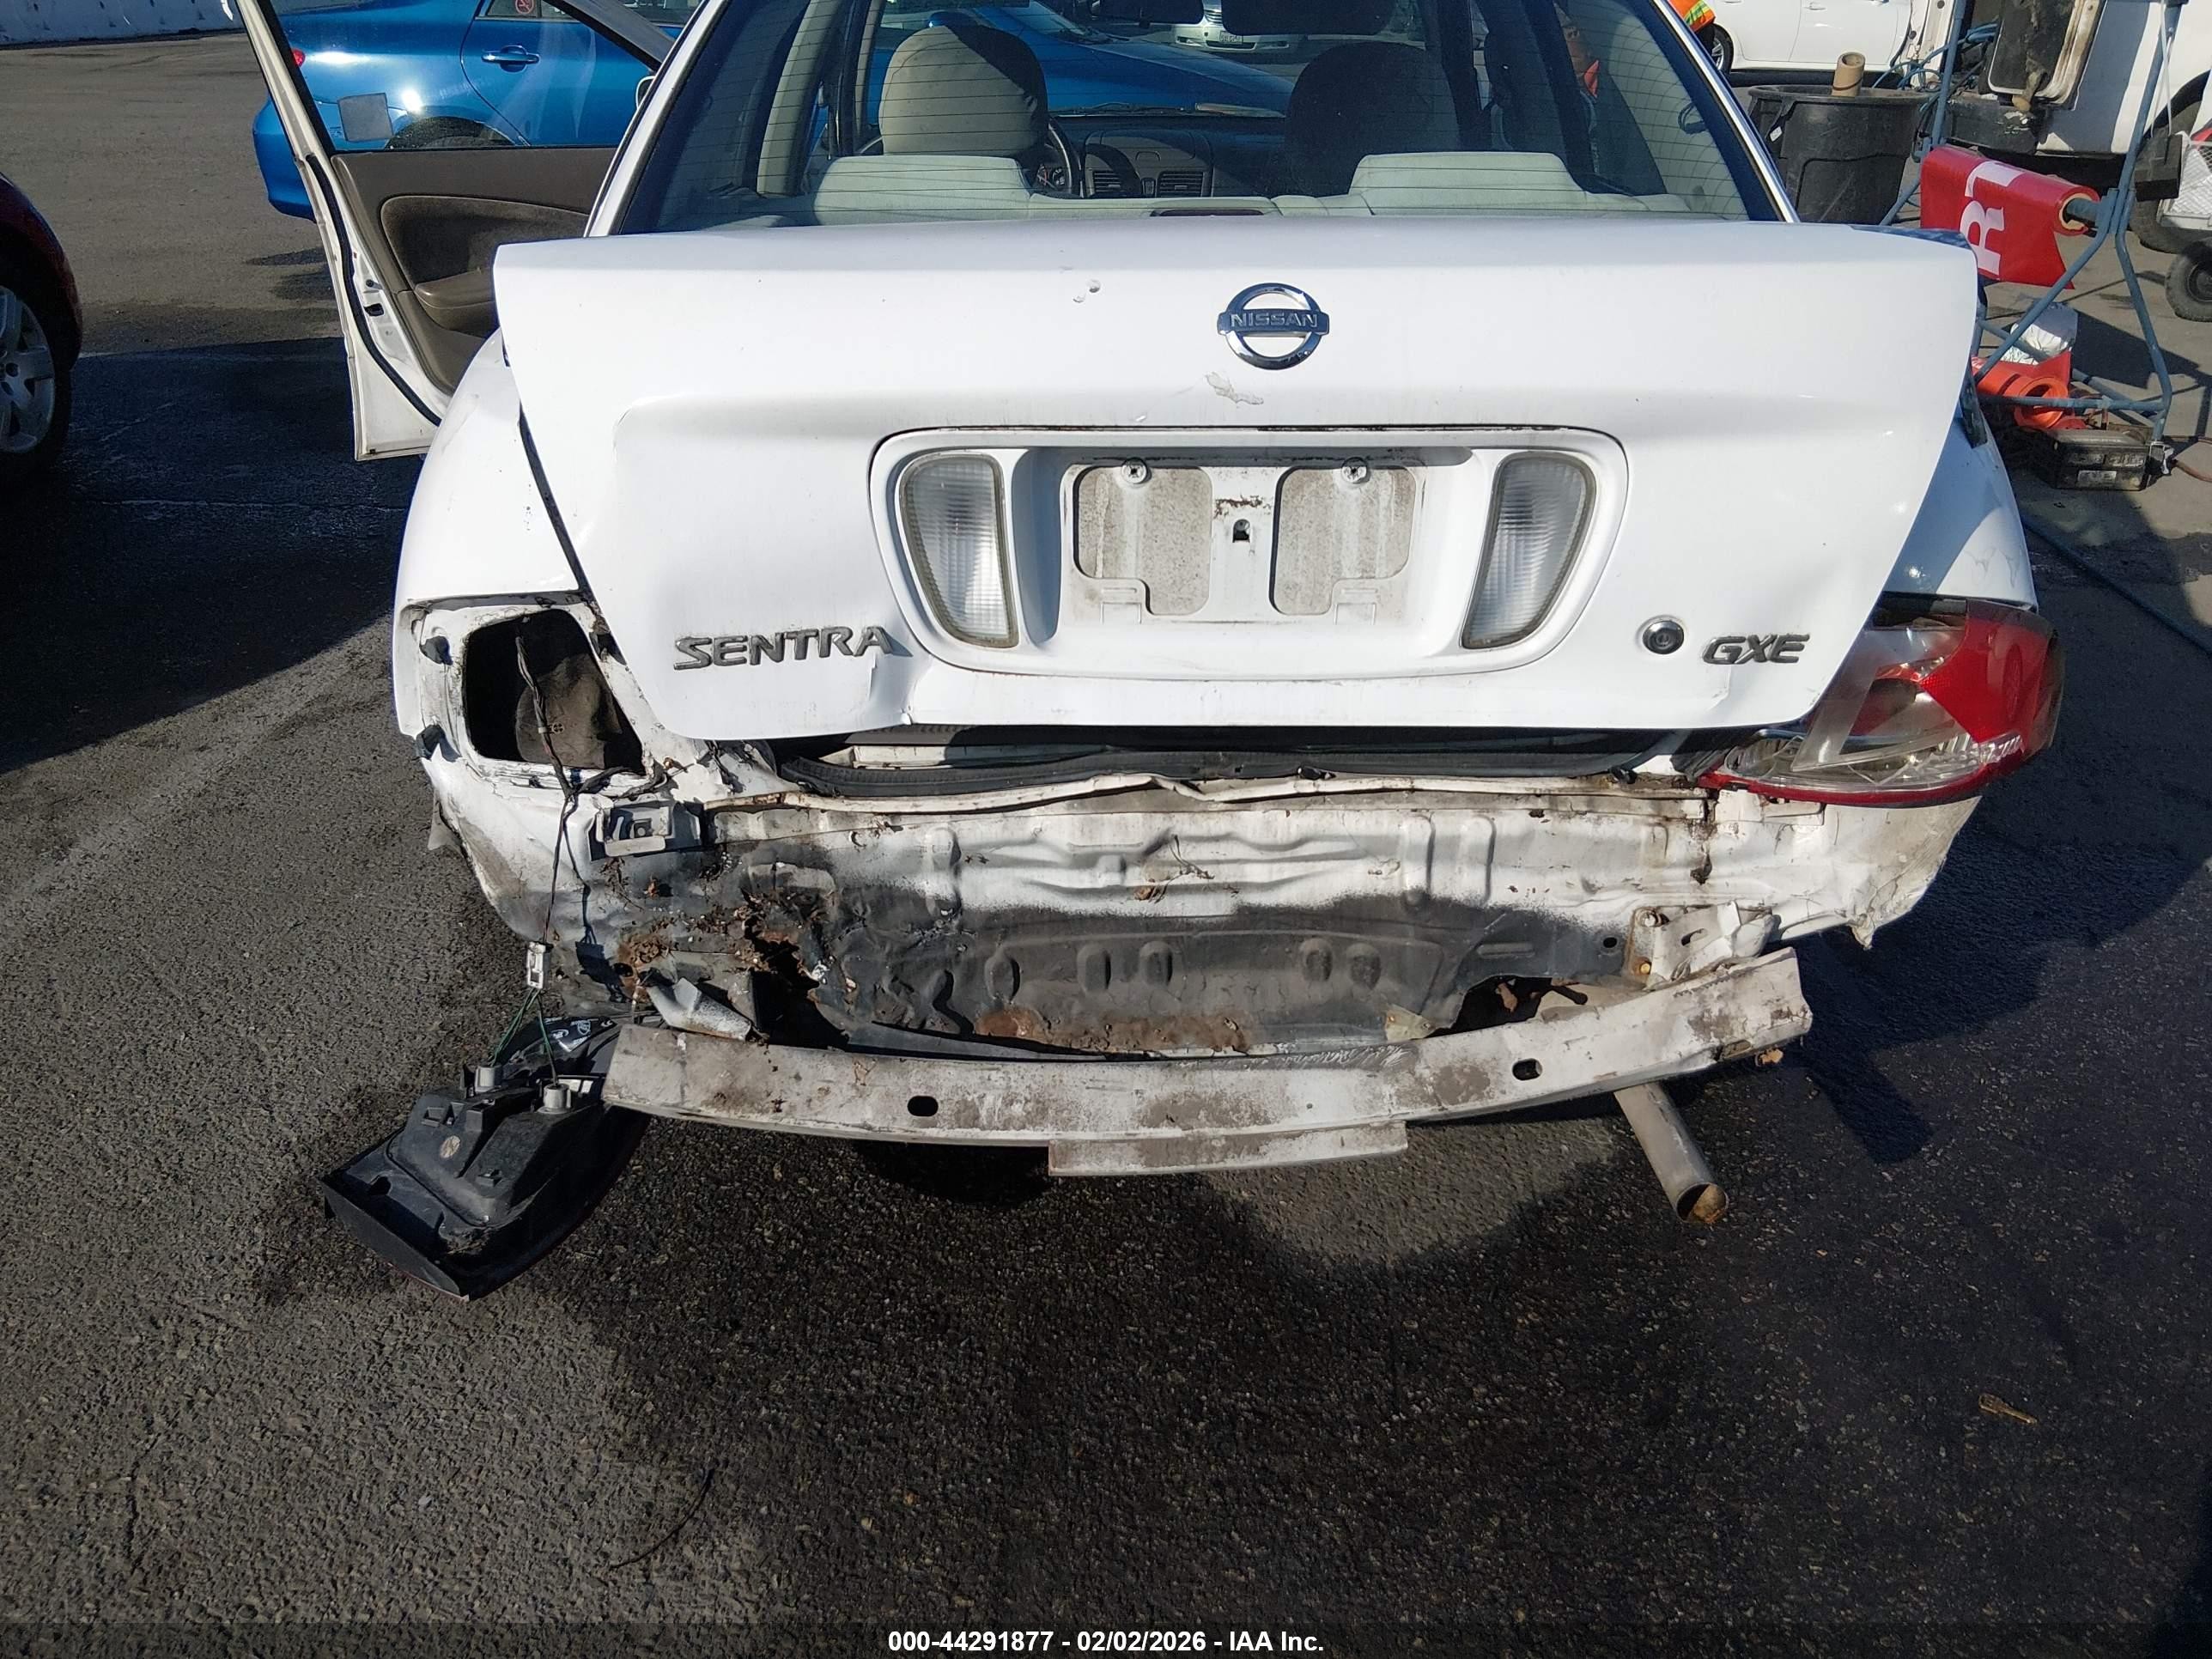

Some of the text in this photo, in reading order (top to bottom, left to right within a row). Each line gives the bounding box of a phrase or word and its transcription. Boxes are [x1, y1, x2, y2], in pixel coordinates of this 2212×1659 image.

[1231, 313, 1317, 327] NISSAN
[673, 626, 894, 670] SENTRA
[1702, 634, 1810, 665] GXE
